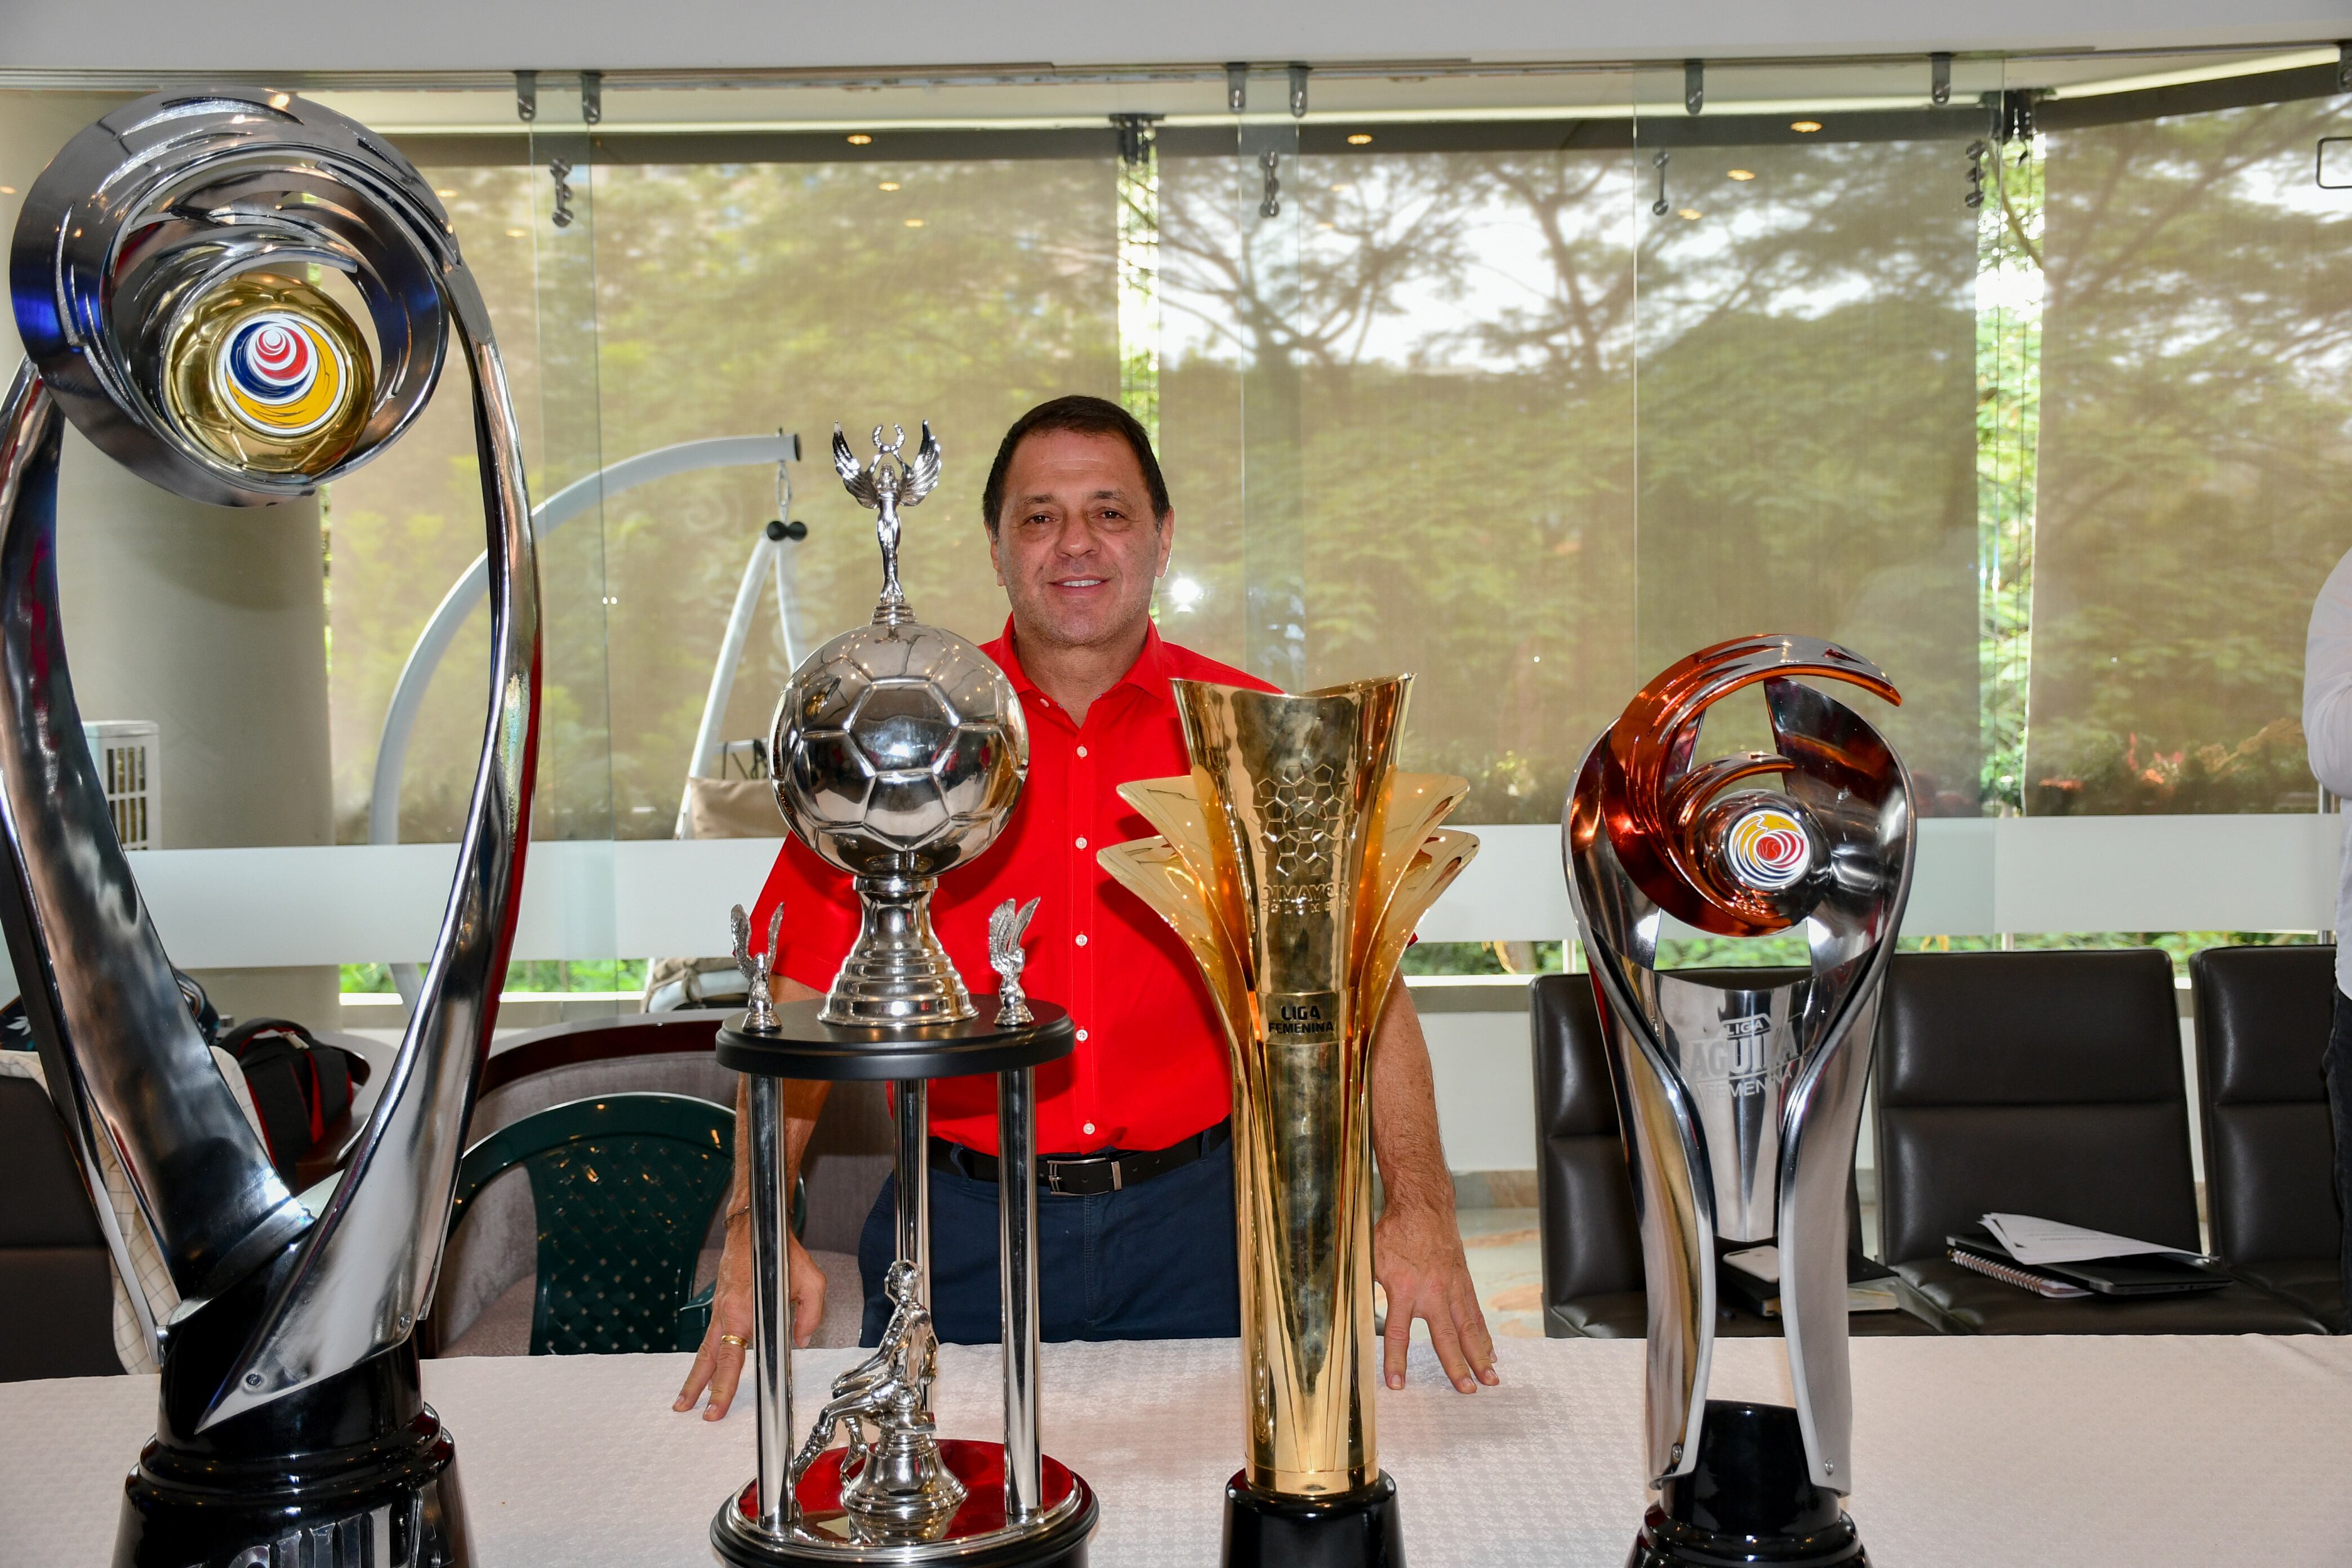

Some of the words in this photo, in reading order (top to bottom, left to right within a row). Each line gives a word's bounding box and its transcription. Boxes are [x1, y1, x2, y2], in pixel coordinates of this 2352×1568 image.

[1259, 881, 1350, 902] DIMAYOR
[1259, 899, 1350, 915] COLOMBIA
[1281, 1005, 1321, 1020] LIGA
[1268, 1021, 1334, 1034] FEMENINA
[1726, 1019, 1763, 1035] LIGA
[1690, 1021, 1799, 1079] AGUILA
